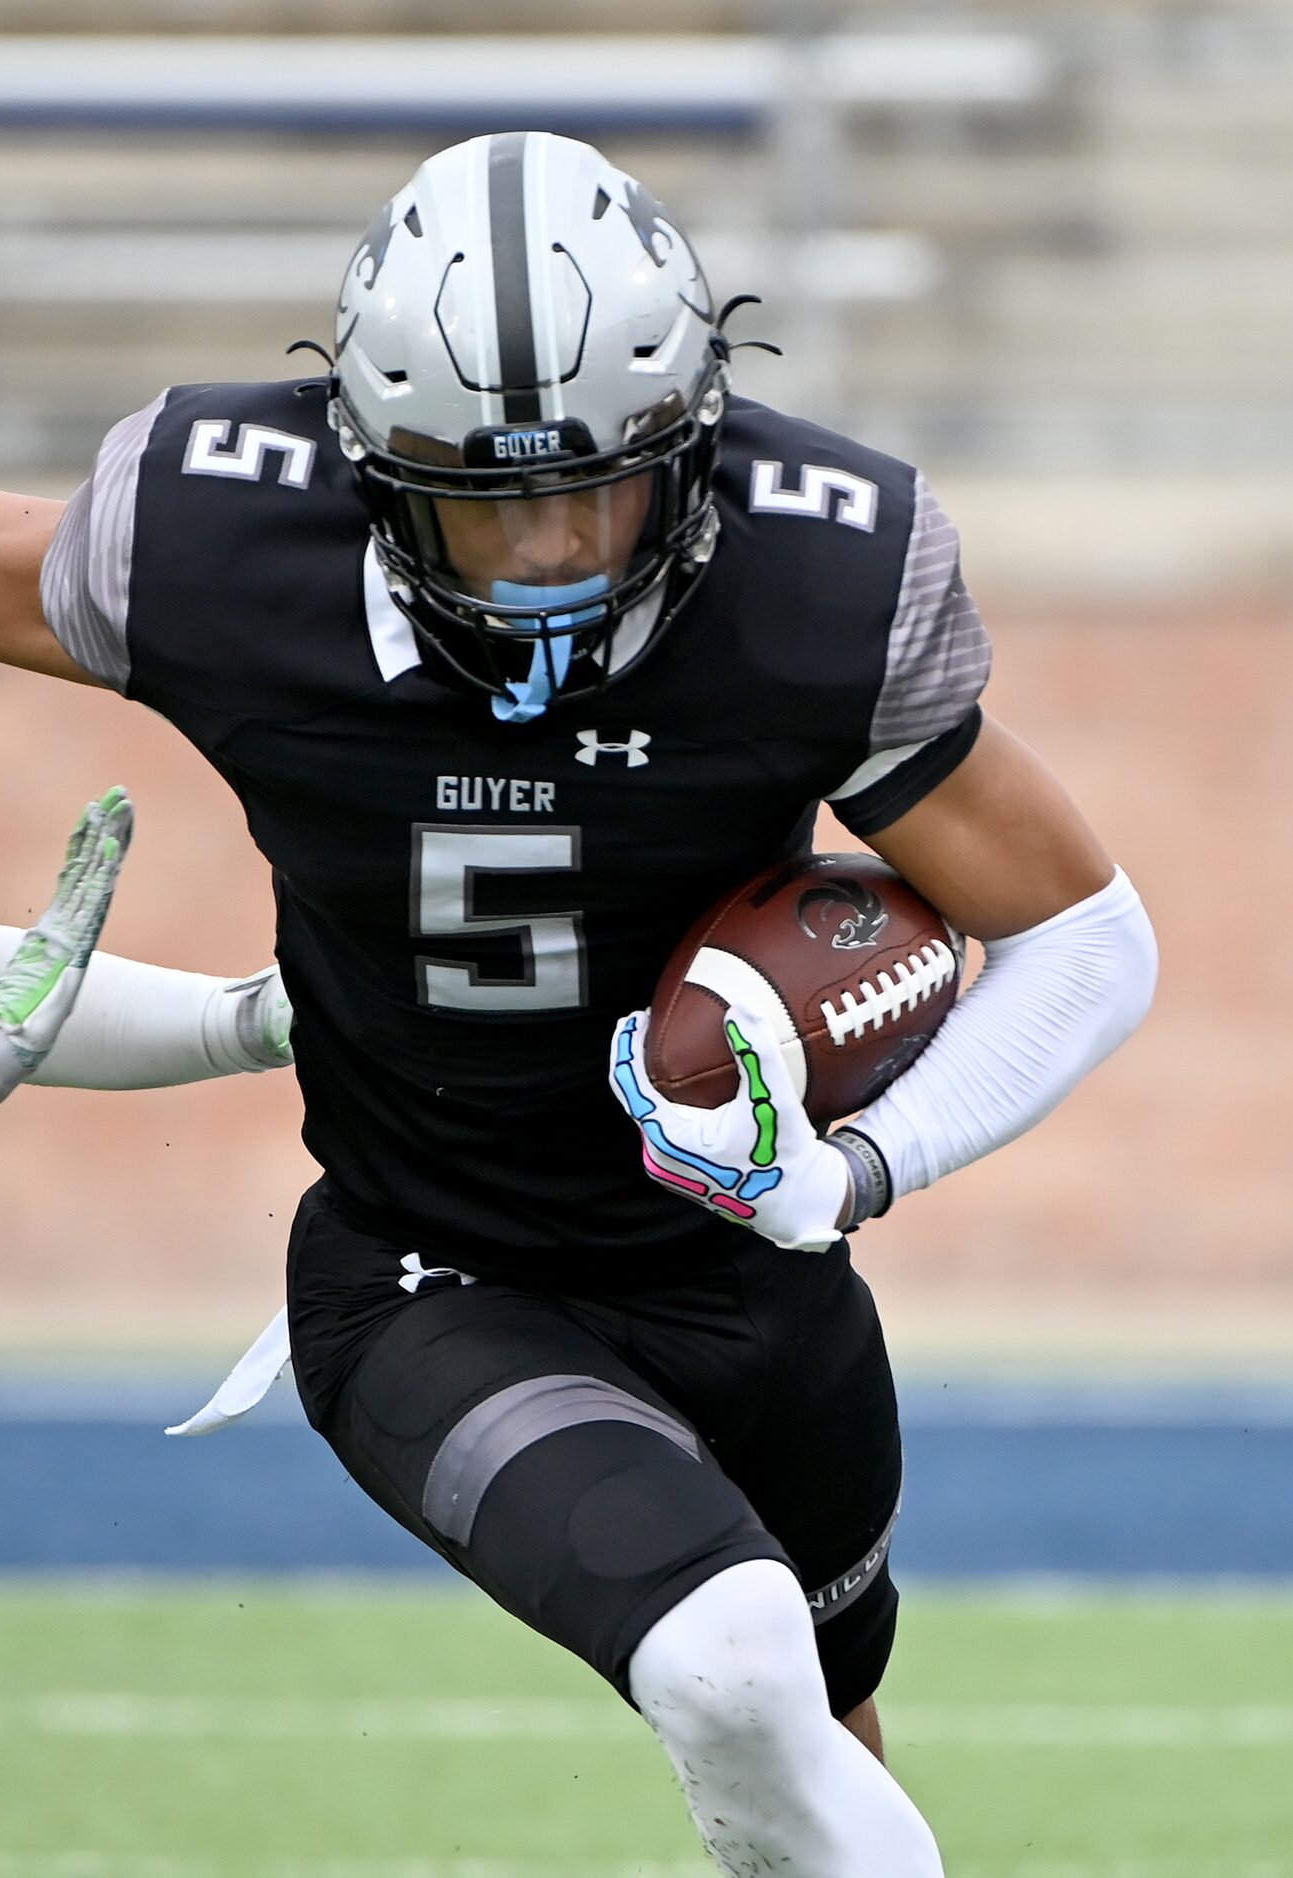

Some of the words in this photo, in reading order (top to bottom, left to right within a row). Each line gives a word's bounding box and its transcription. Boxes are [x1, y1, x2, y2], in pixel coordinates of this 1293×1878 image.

[181, 419, 317, 490] 5
[493, 430, 561, 459] GUYER
[748, 459, 879, 534] 5
[436, 776, 556, 812] GUYER
[409, 822, 590, 1013] 5
